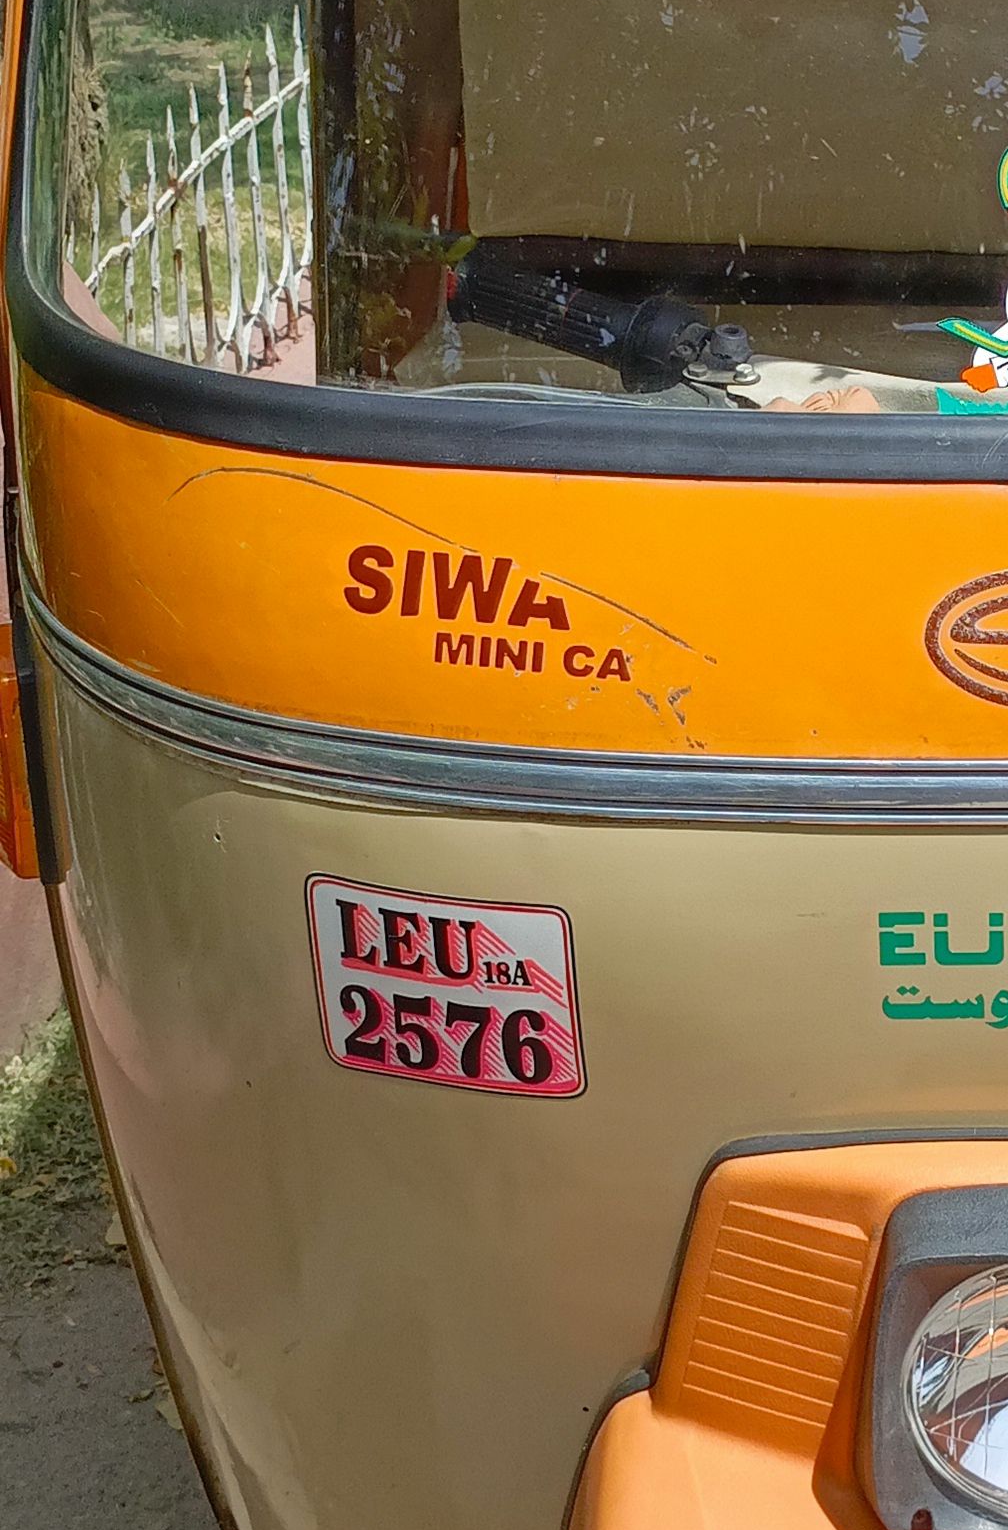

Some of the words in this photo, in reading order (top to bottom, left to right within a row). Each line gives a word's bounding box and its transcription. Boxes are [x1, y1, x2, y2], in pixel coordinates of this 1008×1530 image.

[434, 632, 544, 673] MINI
[336, 899, 477, 980] LEU
[482, 960, 533, 988] 18A
[339, 984, 553, 1086] 2576
